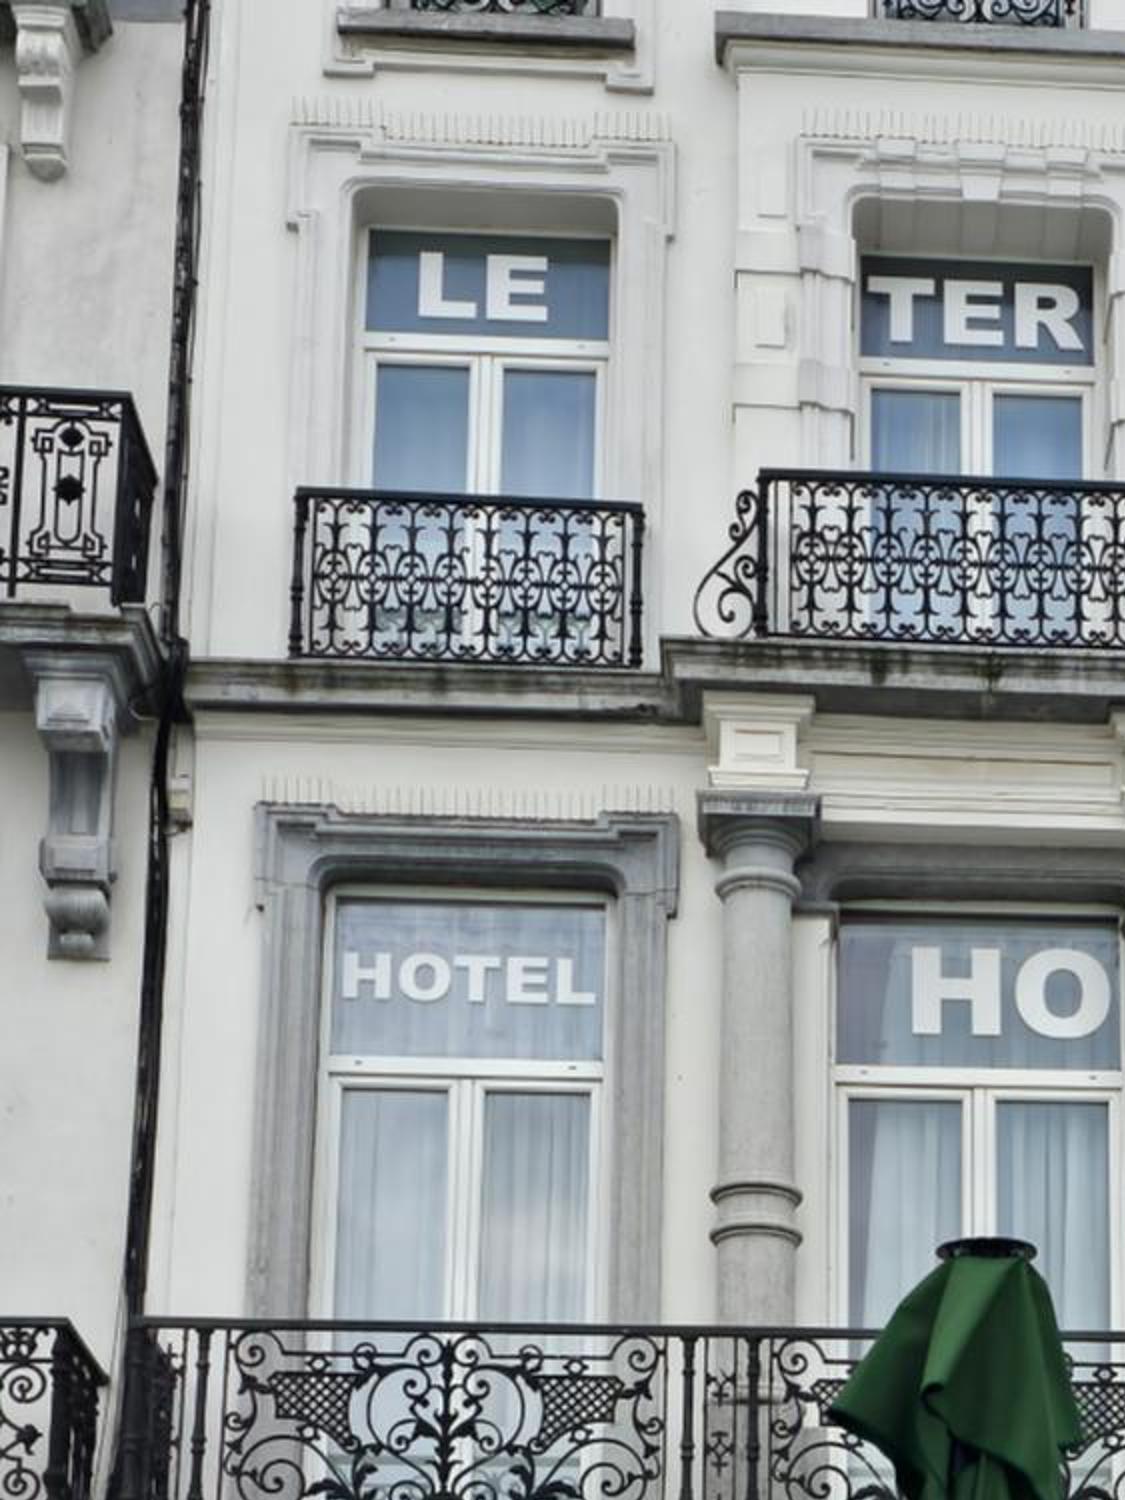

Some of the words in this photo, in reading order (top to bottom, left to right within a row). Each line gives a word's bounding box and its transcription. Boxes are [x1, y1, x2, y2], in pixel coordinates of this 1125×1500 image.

[418, 251, 550, 323] LE
[867, 275, 1085, 351] TER
[341, 951, 597, 1006] HOTEL
[910, 946, 1112, 1041] HO
